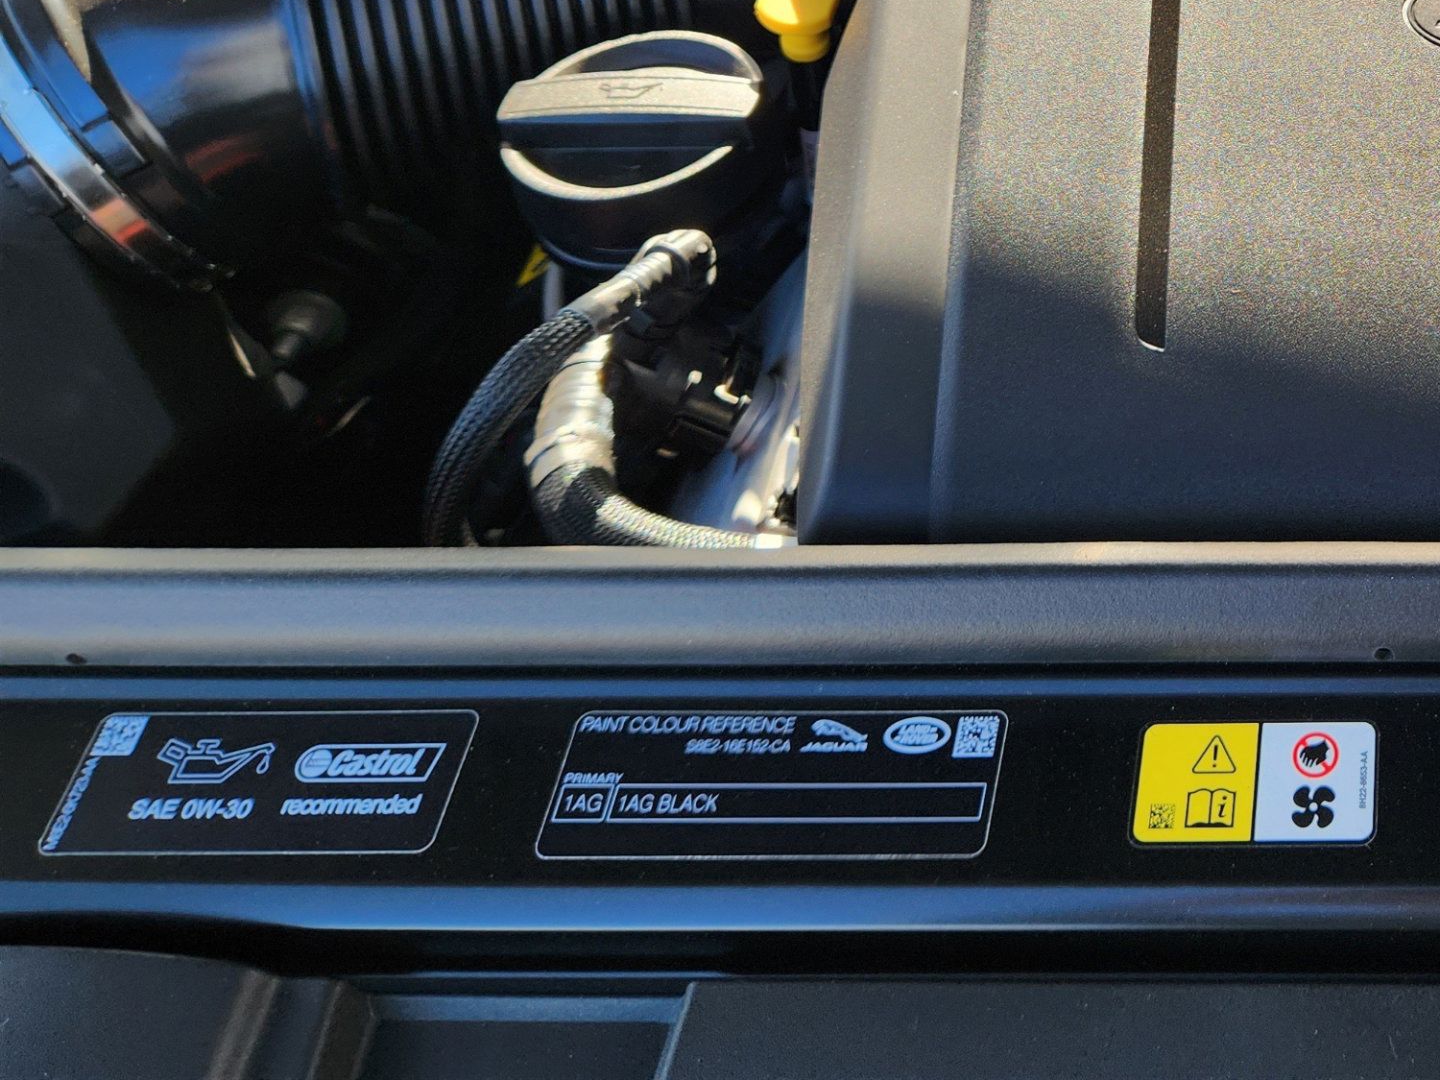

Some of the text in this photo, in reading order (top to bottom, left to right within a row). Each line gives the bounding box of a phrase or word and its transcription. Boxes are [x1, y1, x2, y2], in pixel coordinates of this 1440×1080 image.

[579, 715, 797, 735] PAINT COLOUR REFERENCE
[800, 741, 868, 753] JAGUAR
[326, 748, 419, 777] Castrol
[563, 773, 623, 783] PRIMARY
[128, 798, 254, 820] SAE 0W-30
[280, 794, 423, 816] recommended
[564, 792, 602, 814] 1AG
[618, 793, 719, 814] 1AG BLACK
